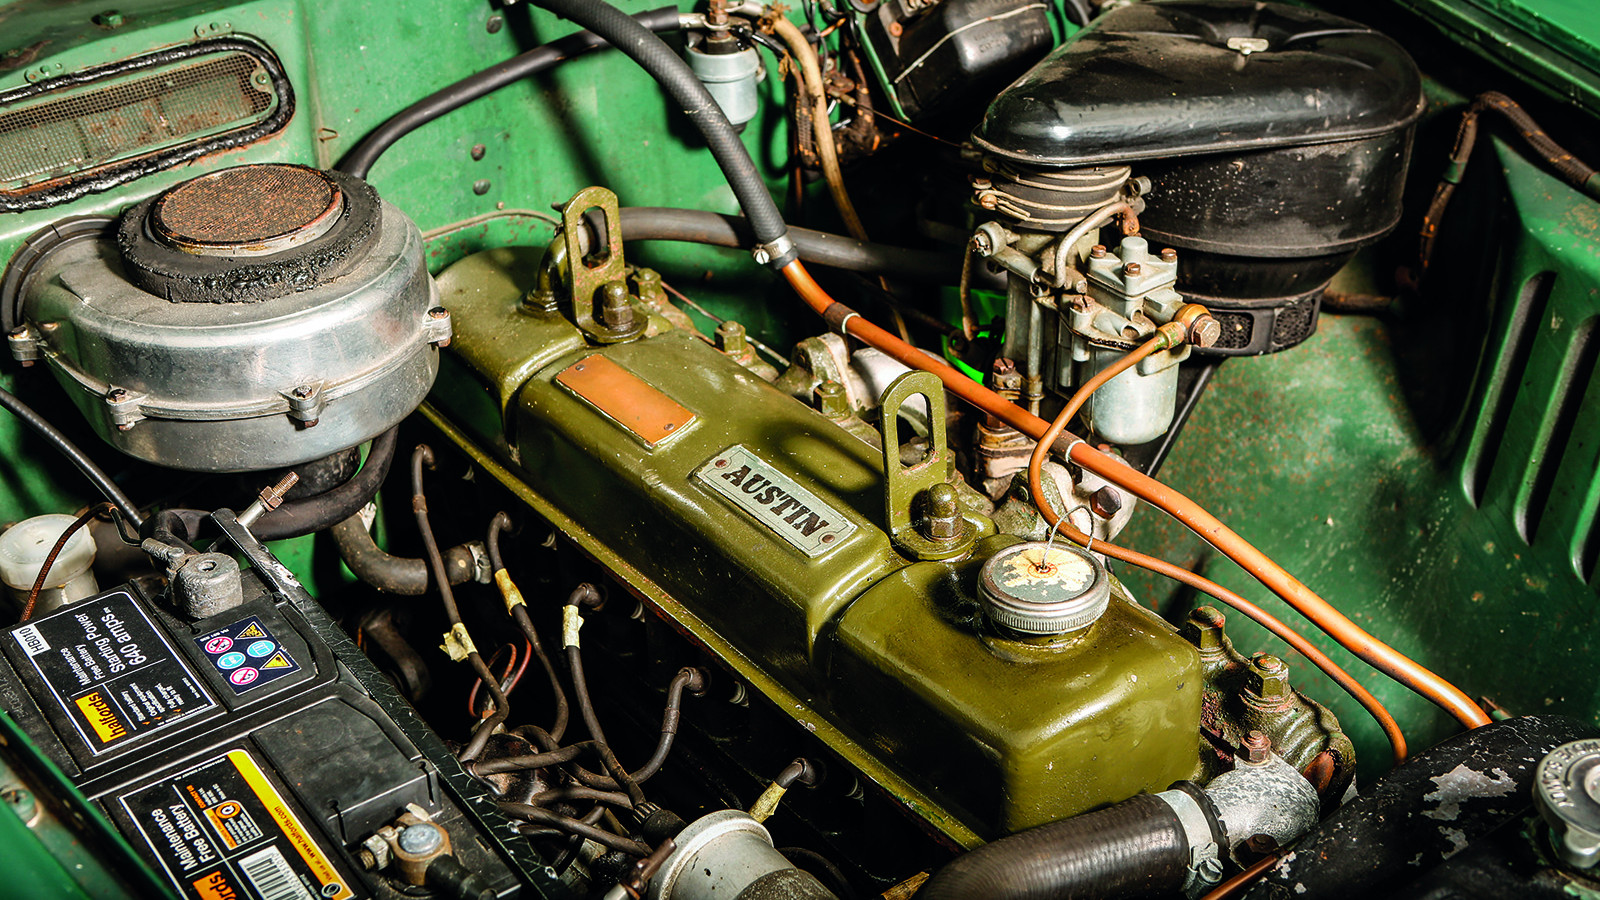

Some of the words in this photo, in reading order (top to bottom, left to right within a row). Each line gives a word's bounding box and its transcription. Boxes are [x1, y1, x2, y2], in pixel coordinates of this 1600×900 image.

[721, 465, 829, 537] AUSTIN
[19, 628, 44, 652] HB010
[75, 613, 101, 640] Power
[101, 614, 131, 643] amps
[60, 648, 91, 686] Maintenance
[75, 644, 96, 667] Battery
[95, 638, 127, 673] Starting
[120, 644, 146, 665] 640
[91, 665, 105, 680] Free
[89, 692, 126, 737] halfords
[189, 789, 206, 808] CONTACT
[169, 804, 206, 840] Battery
[151, 809, 198, 870] Maintenance
[193, 838, 215, 863] Free
